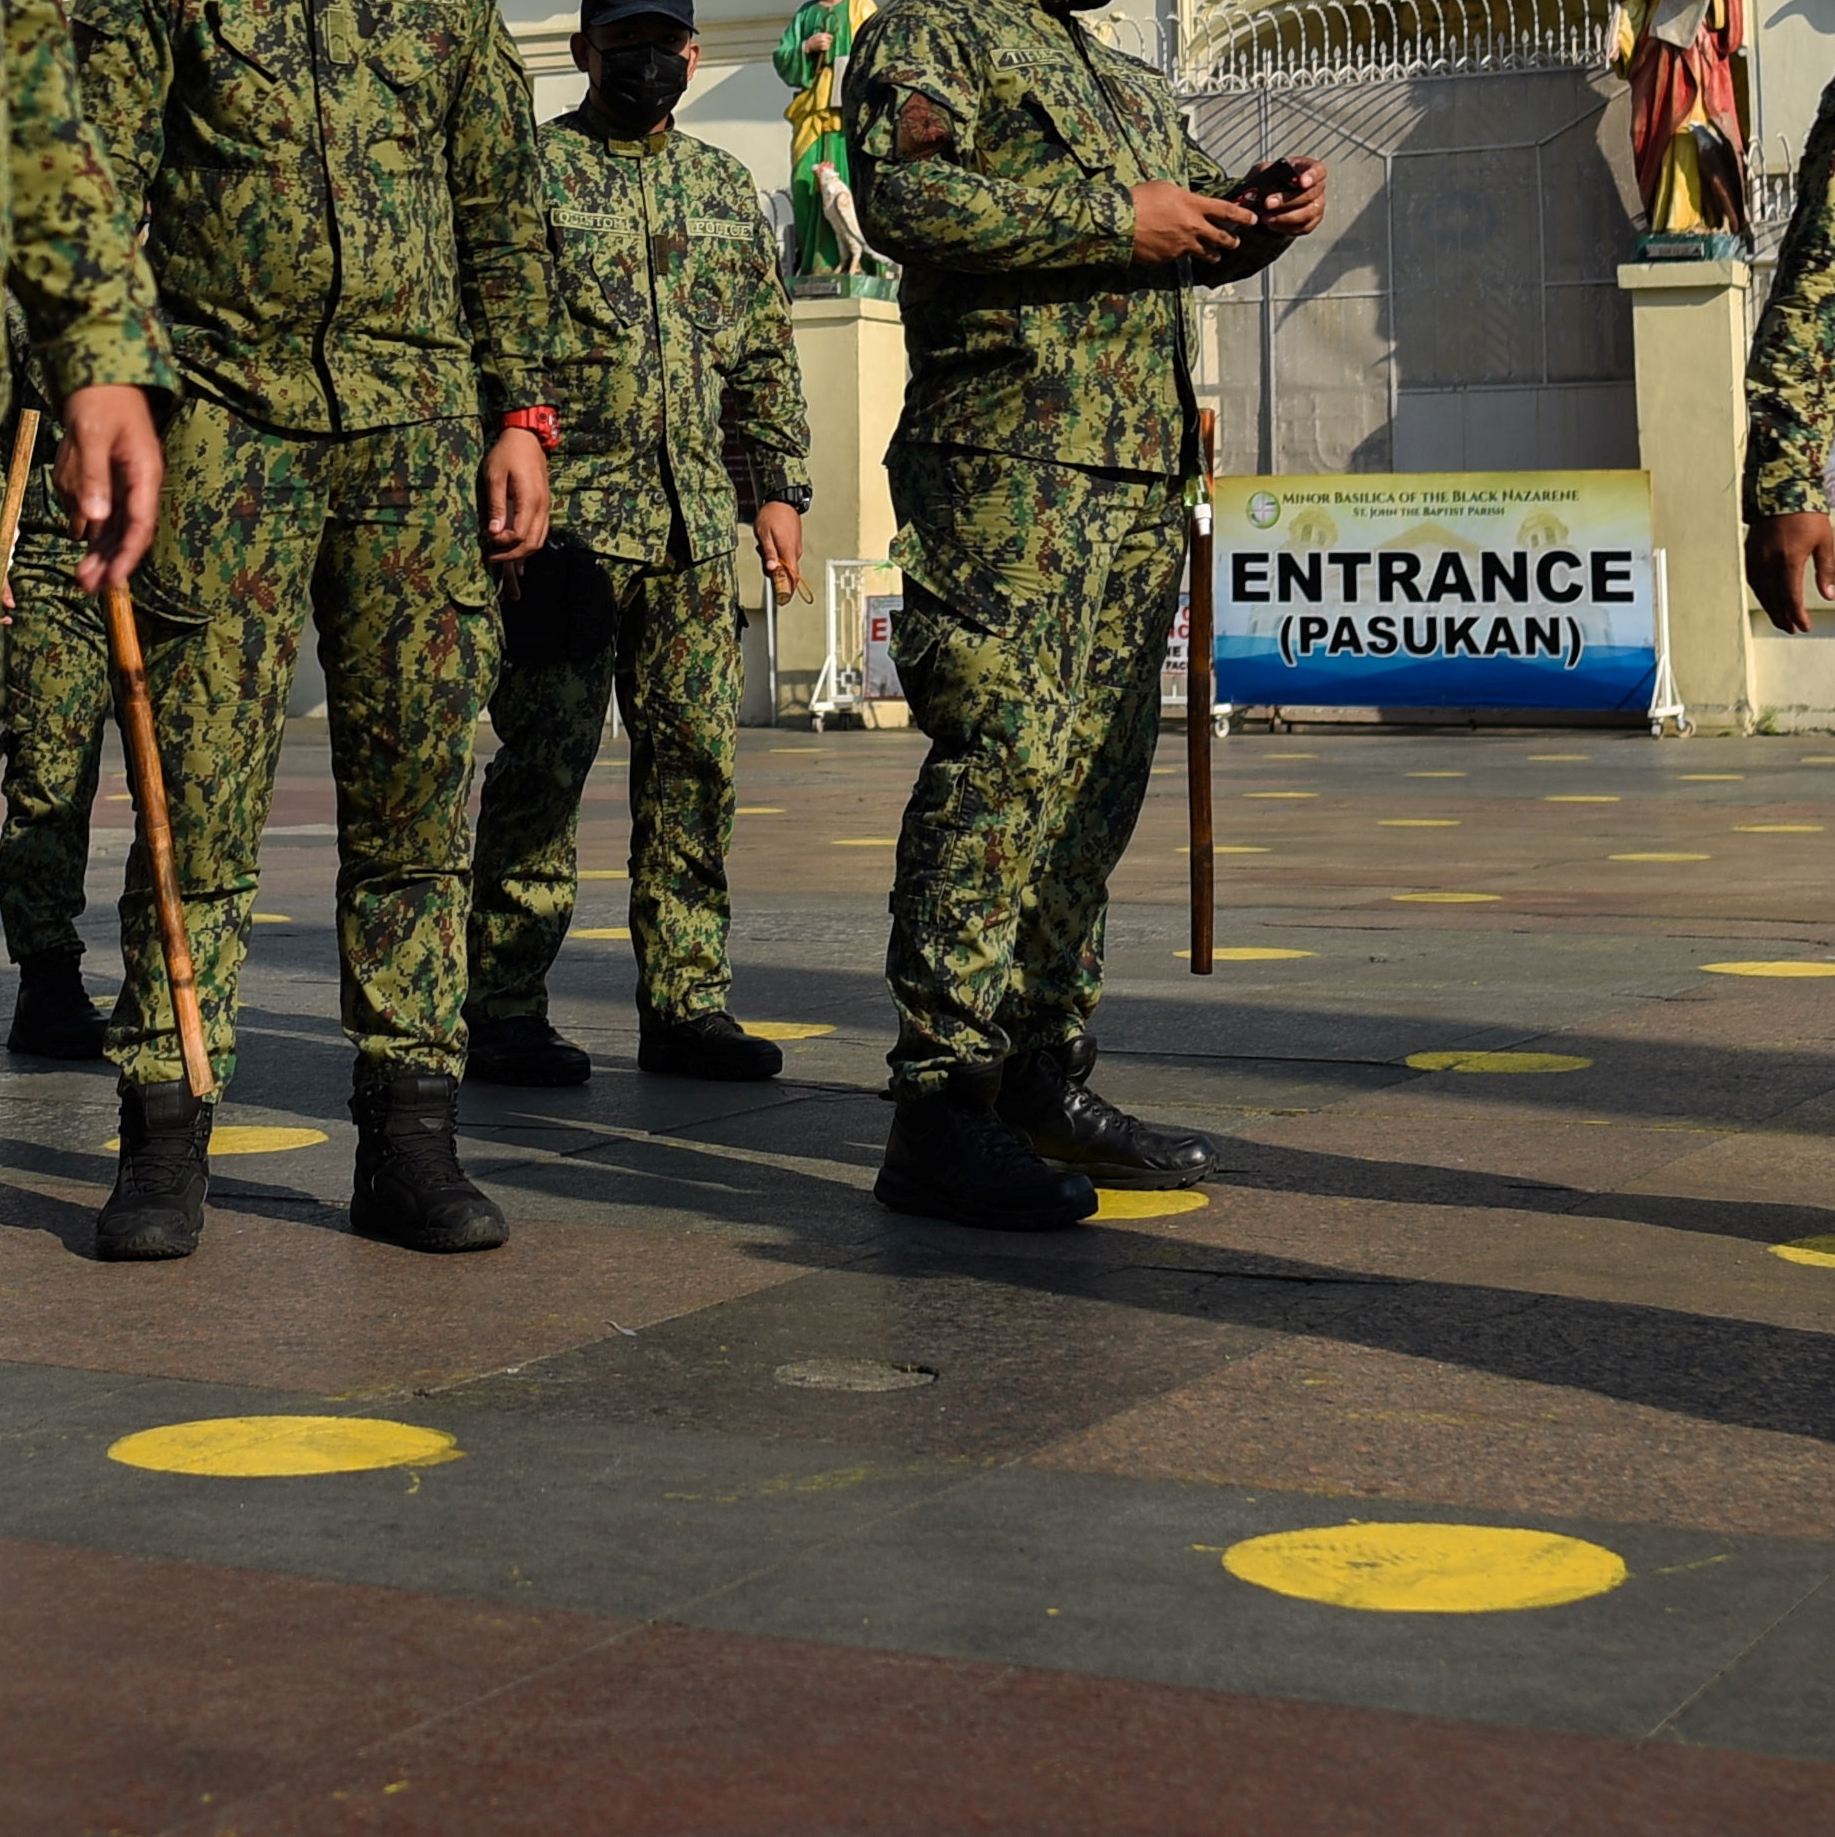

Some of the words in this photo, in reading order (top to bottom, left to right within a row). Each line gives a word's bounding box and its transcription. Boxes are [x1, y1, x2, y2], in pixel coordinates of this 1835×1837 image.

[695, 222, 751, 238] POLICE
[1282, 492, 1330, 504] MINOR
[1334, 491, 1395, 504] BASILICA
[1398, 491, 1417, 503] OF
[1423, 490, 1448, 503] THE
[1452, 490, 1498, 502] BLACK
[1502, 489, 1580, 502] NAZARENE
[1369, 507, 1397, 519] JOHN
[1401, 507, 1420, 517] THE
[1423, 506, 1465, 517] BAPTIST
[1467, 506, 1505, 516] PARISH
[1231, 550, 1634, 603] ENTRANCE
[1280, 615, 1583, 668] (PASUKAN)
